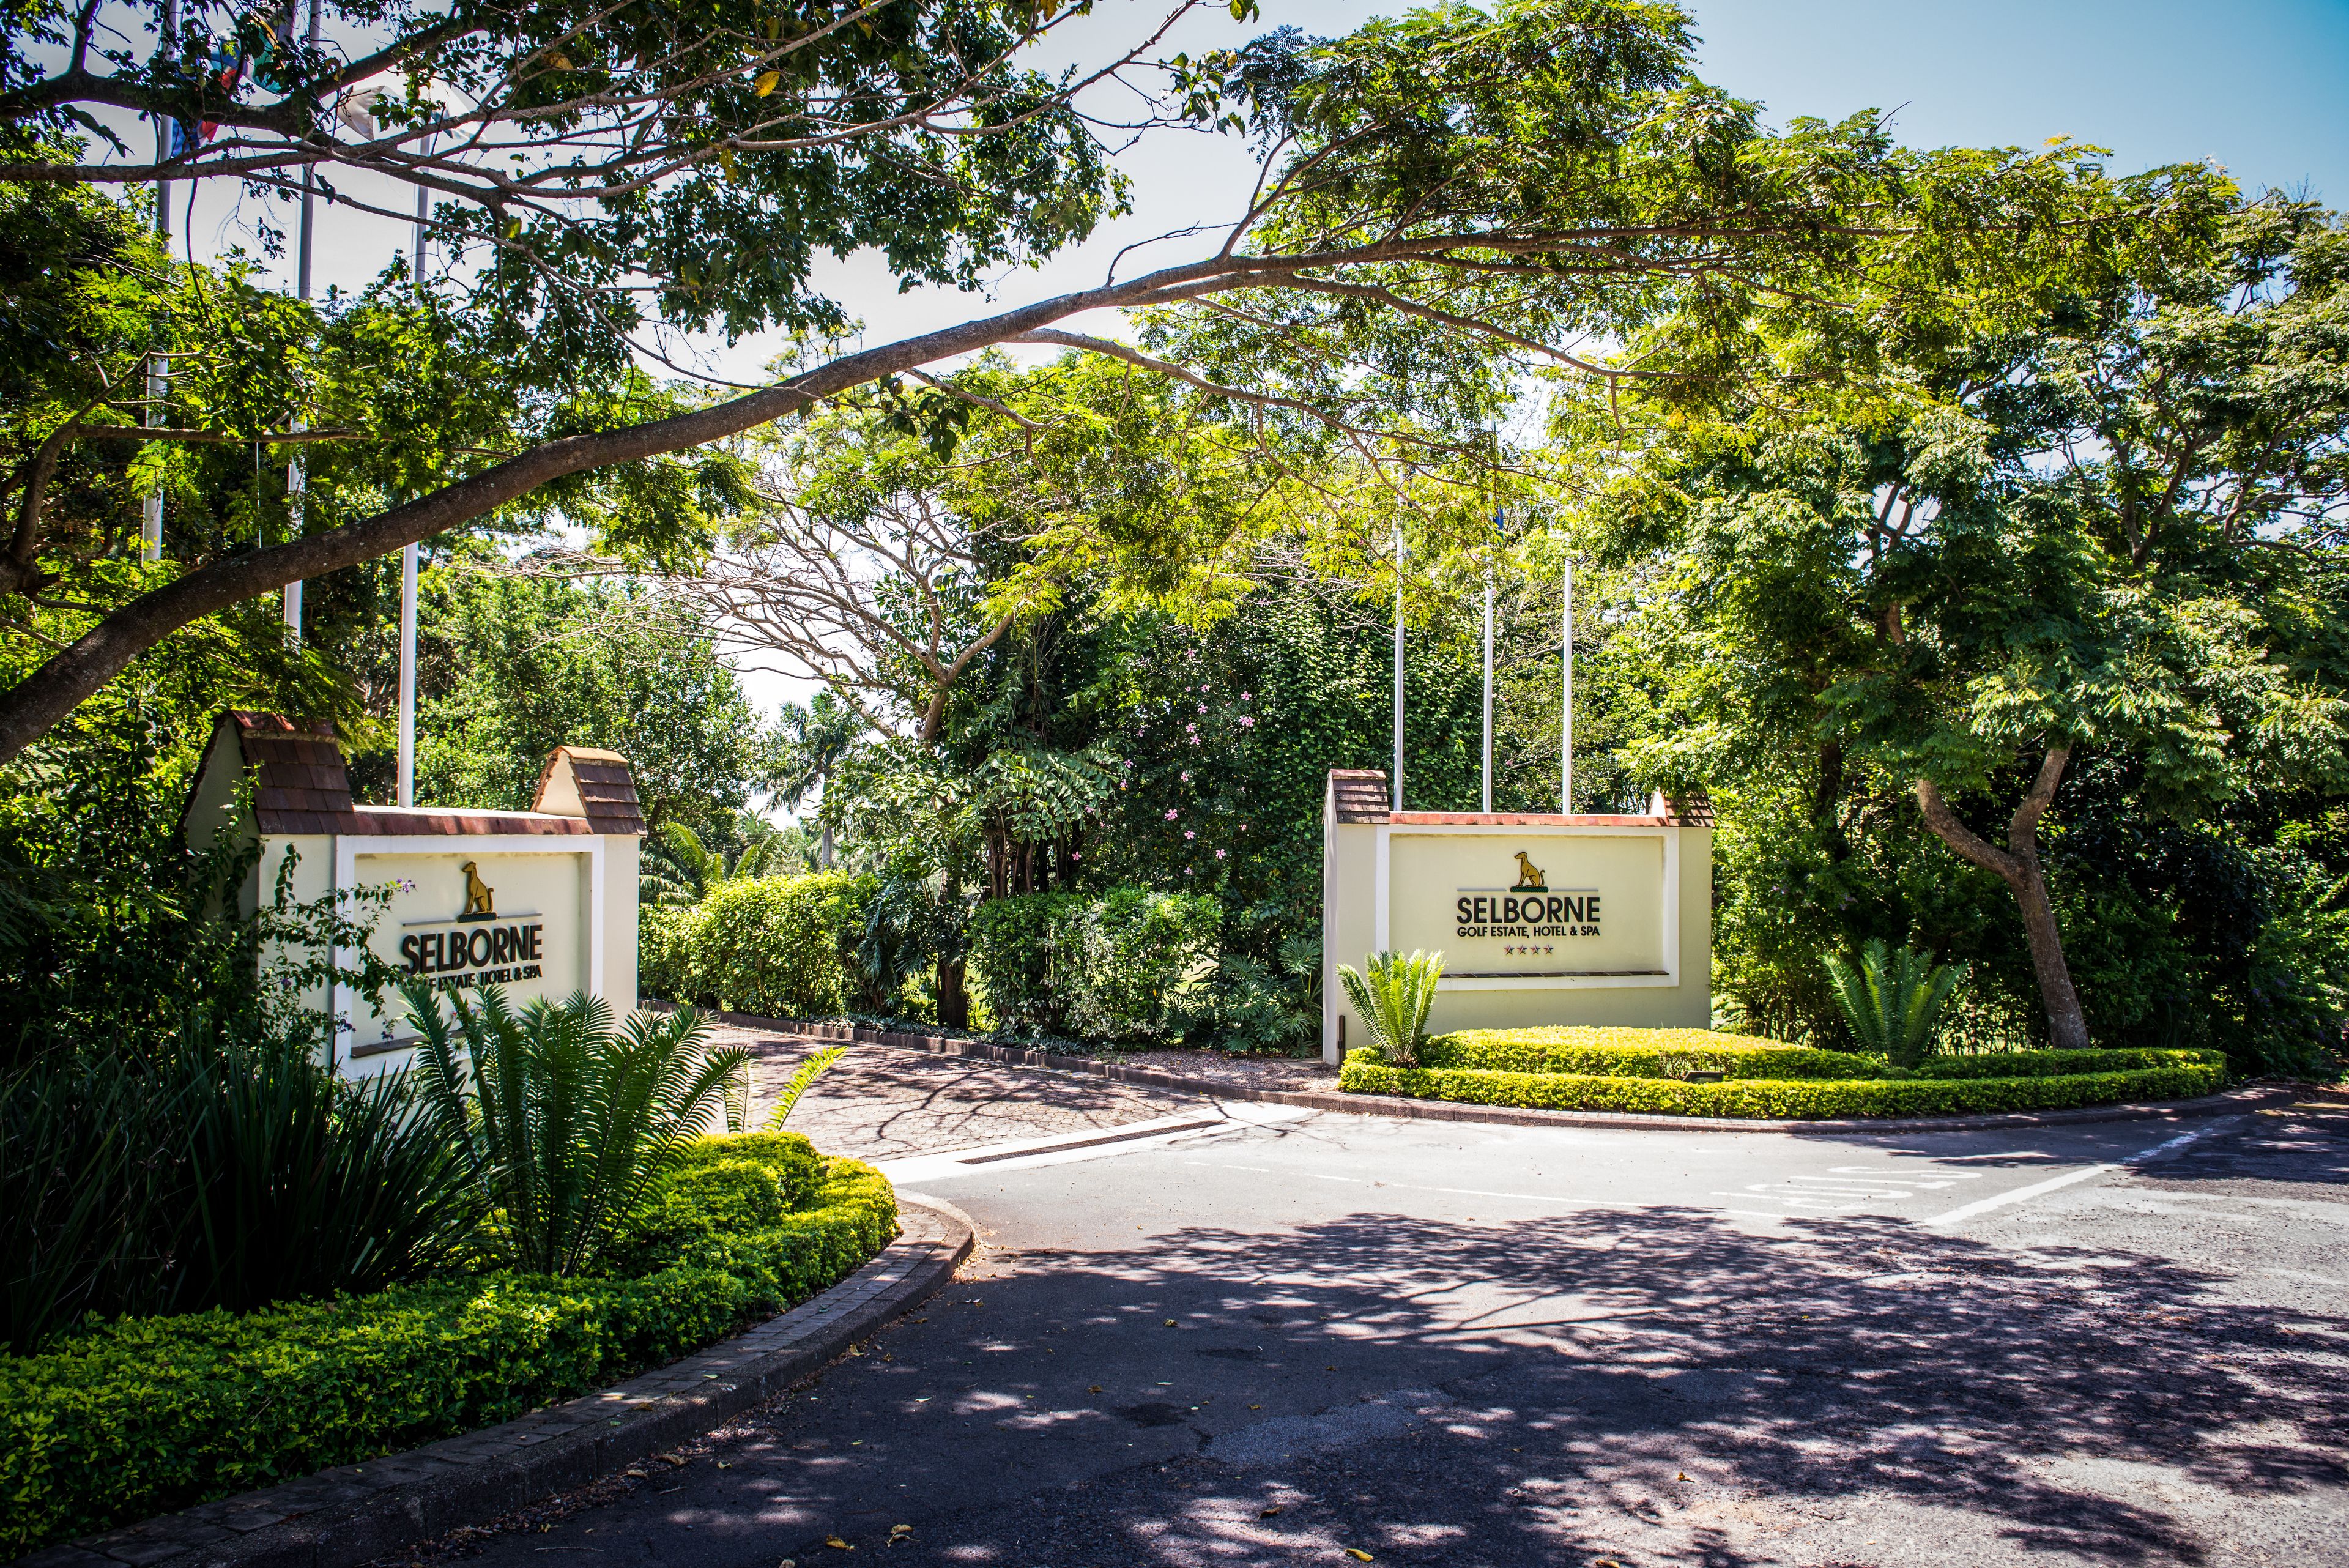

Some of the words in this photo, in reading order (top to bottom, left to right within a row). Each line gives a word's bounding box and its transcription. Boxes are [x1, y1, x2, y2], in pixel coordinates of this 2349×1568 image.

[1457, 897, 1600, 923] SELBORNE
[1457, 926, 1488, 937] GOLF
[1491, 926, 1529, 938] ESTATE,
[1534, 926, 1566, 937] HOTEL
[1570, 926, 1578, 936] &
[1580, 926, 1600, 936] SPA
[401, 924, 543, 976] SELBORNE
[480, 968, 513, 986] HOTEL
[514, 967, 522, 981] &
[523, 964, 543, 980] SPA
